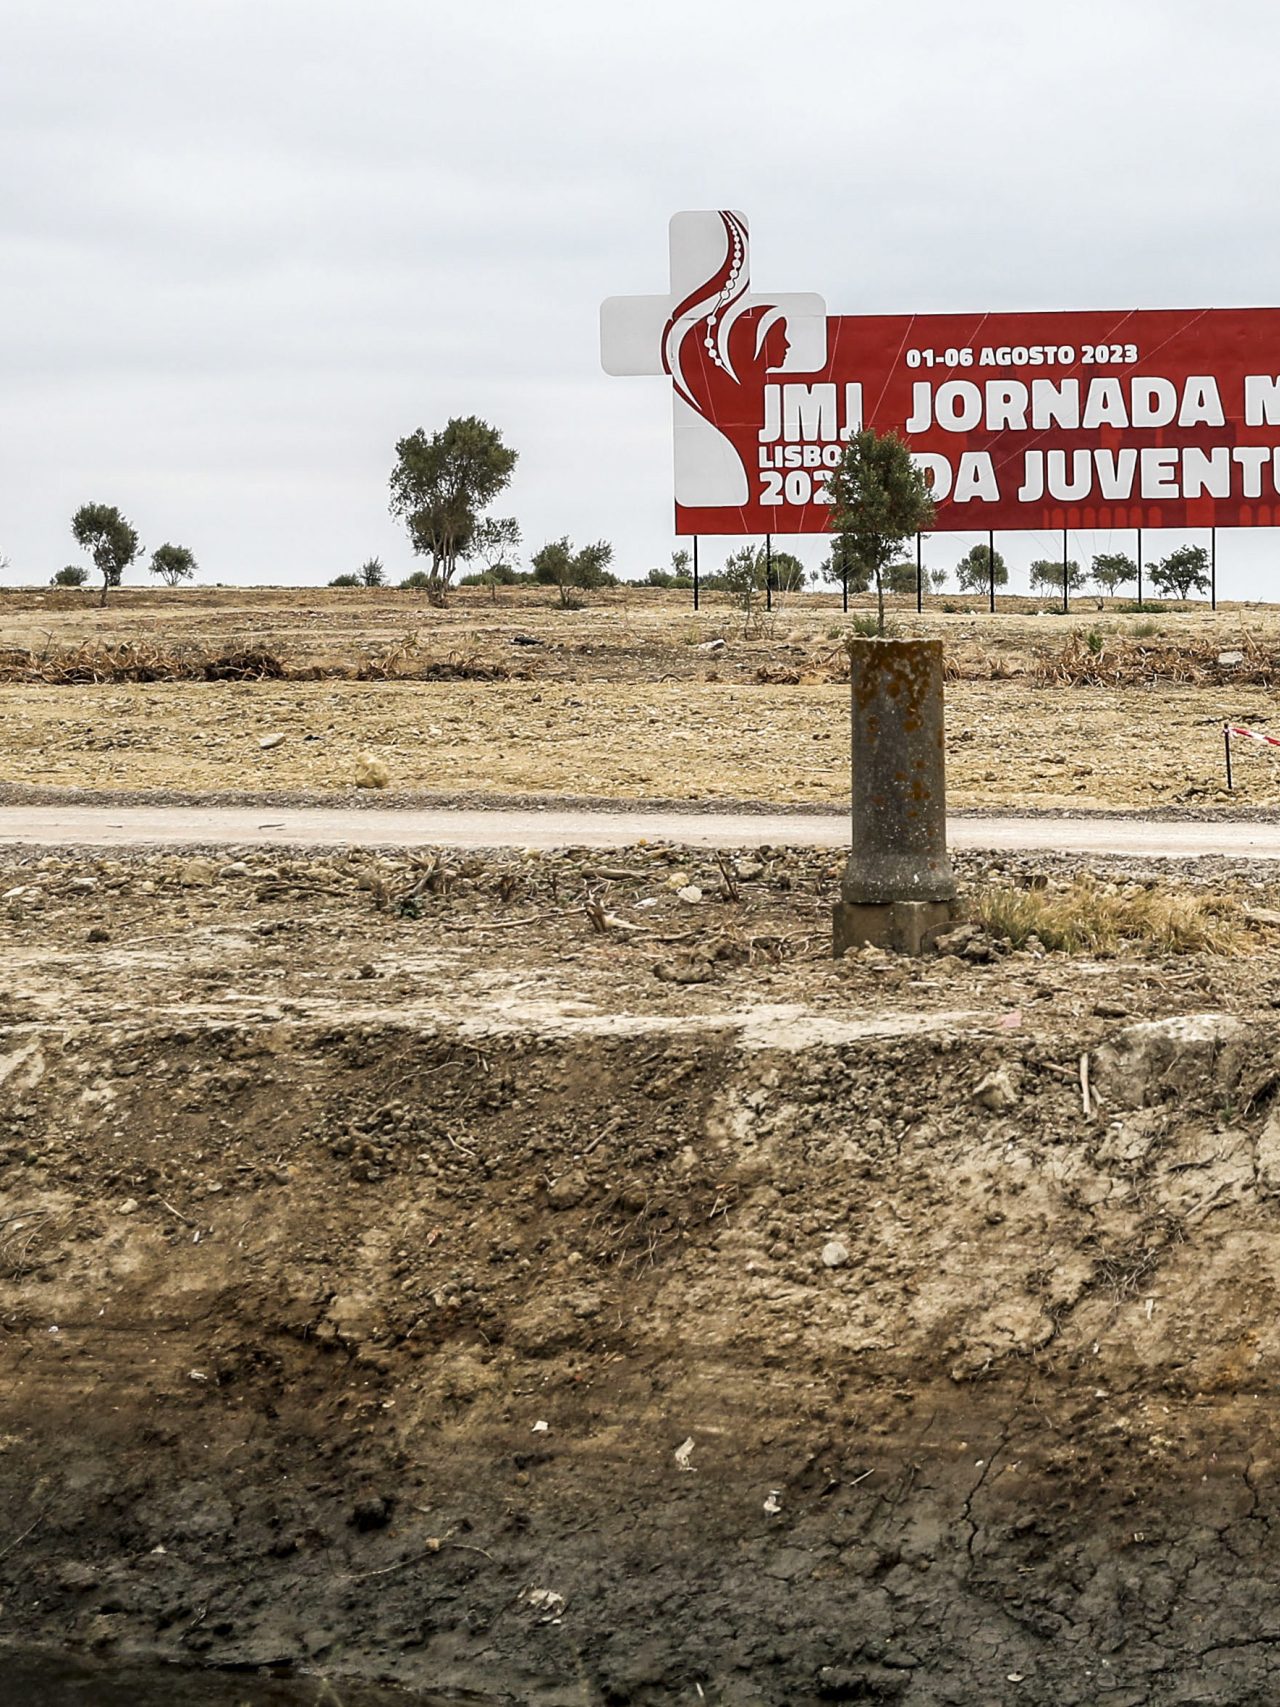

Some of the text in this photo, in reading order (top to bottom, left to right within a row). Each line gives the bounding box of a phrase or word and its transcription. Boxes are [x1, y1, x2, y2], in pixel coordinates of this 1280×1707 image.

[906, 344, 1138, 368] 01-06 AGOSTO 2023
[758, 382, 864, 443] JMJ
[905, 375, 1226, 434] JORNADA
[758, 444, 863, 468] LISBO
[907, 451, 1000, 503] DA
[759, 470, 861, 506] 202
